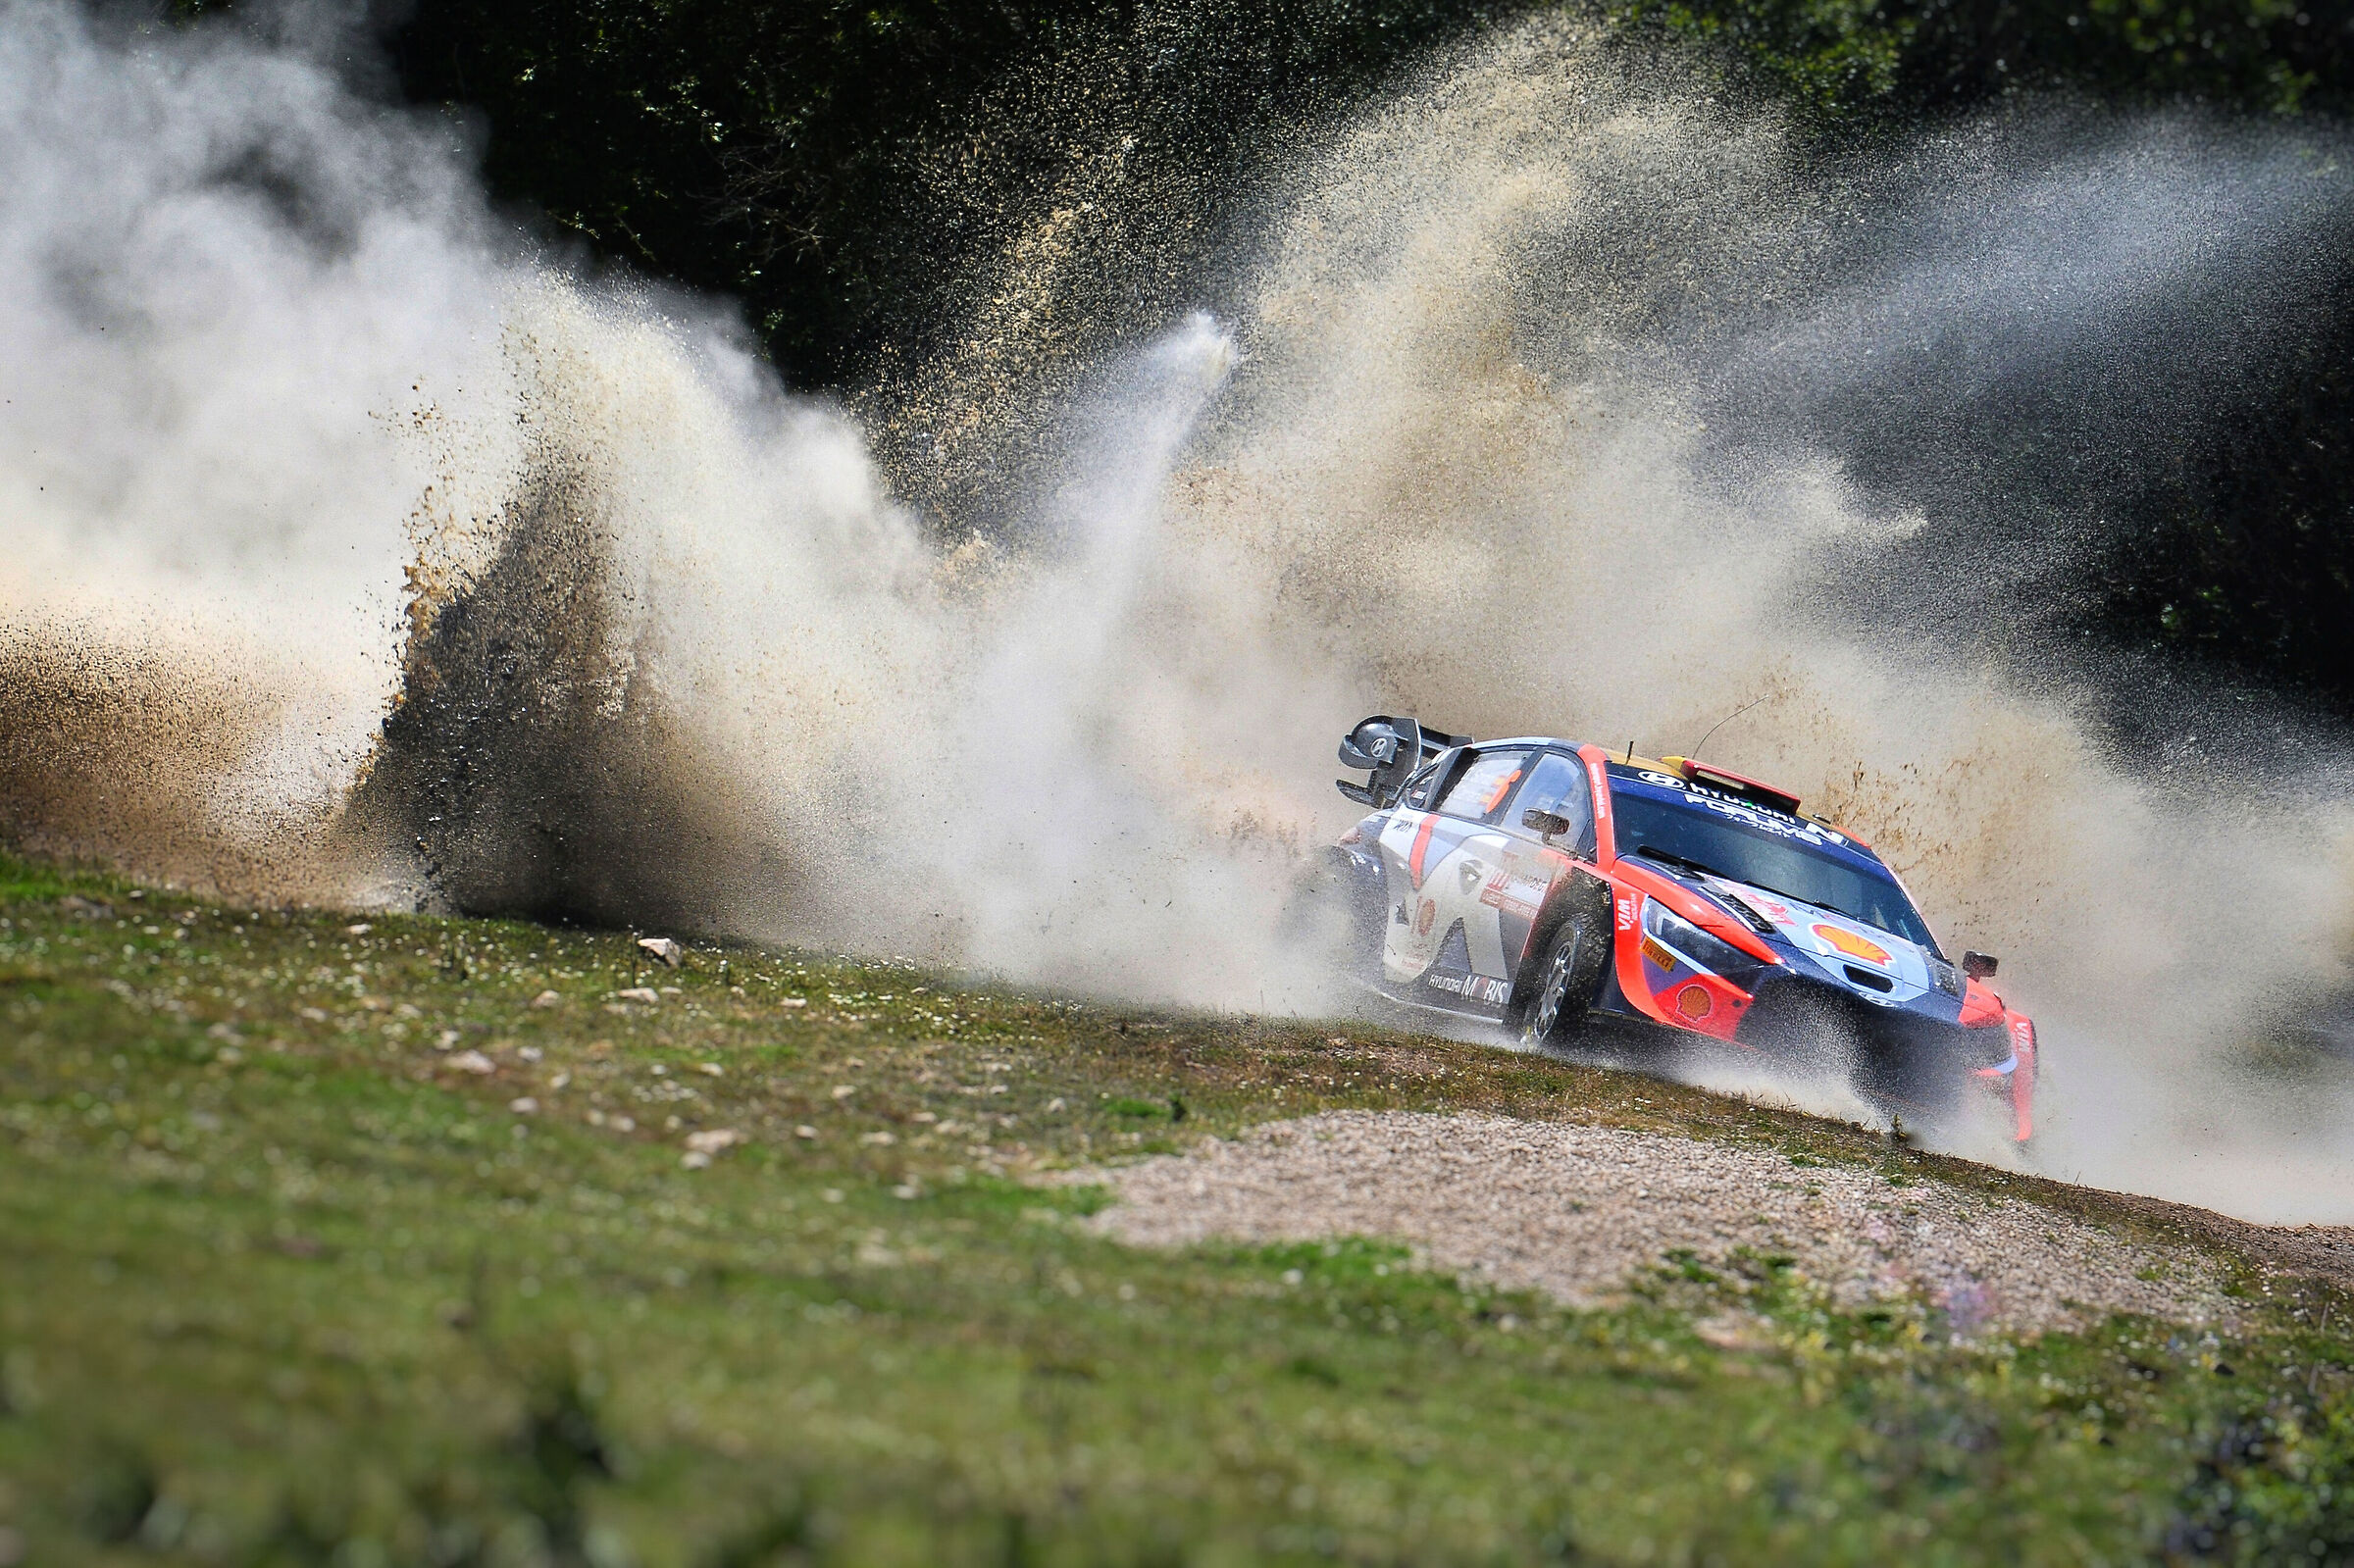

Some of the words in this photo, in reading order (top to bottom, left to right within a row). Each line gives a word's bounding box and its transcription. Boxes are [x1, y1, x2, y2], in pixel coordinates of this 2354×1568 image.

[1617, 898, 1632, 931] VIM
[1428, 974, 1463, 993] HYUNDAI
[1461, 975, 1509, 1004] MOBIS
[2016, 1022, 2030, 1053] VIM
